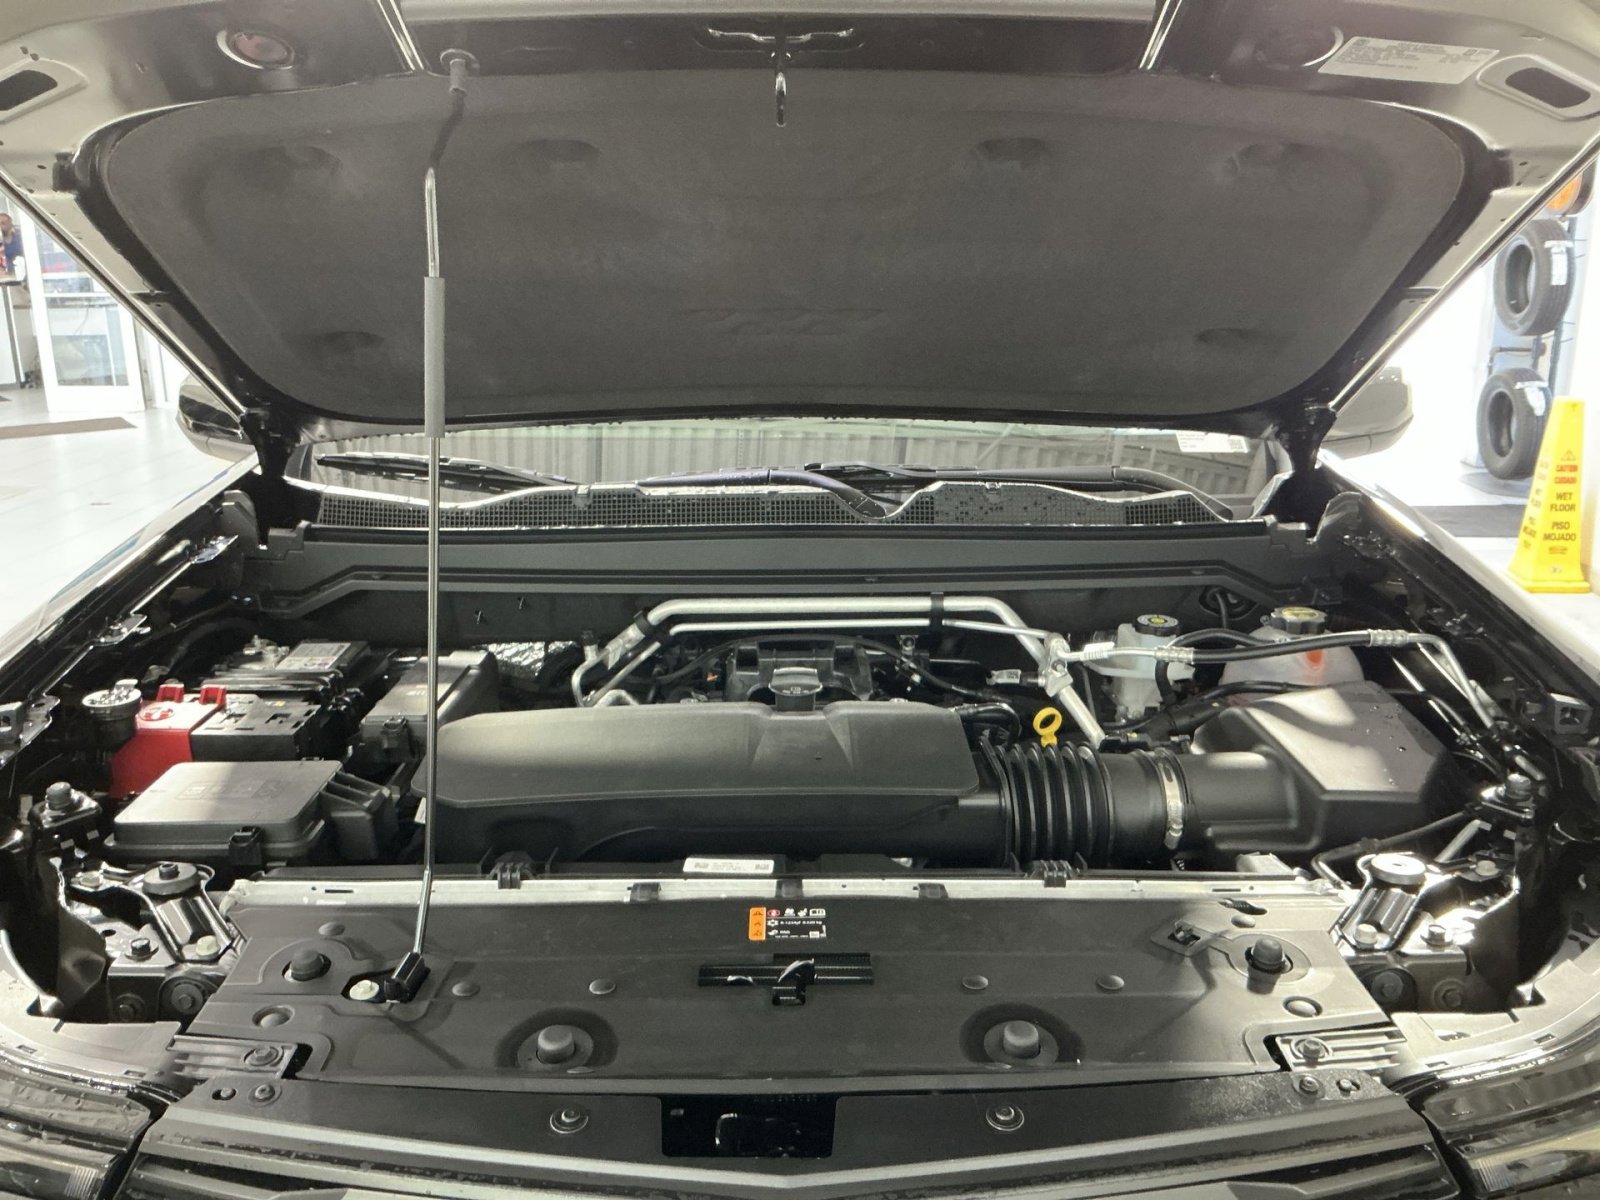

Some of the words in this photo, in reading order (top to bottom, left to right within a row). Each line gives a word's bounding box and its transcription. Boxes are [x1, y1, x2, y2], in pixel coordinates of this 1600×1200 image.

[1556, 492, 1573, 501] WET
[1550, 503, 1576, 512] FLOOR
[1551, 521, 1570, 530] PISO
[1543, 532, 1576, 542] MOJADO
